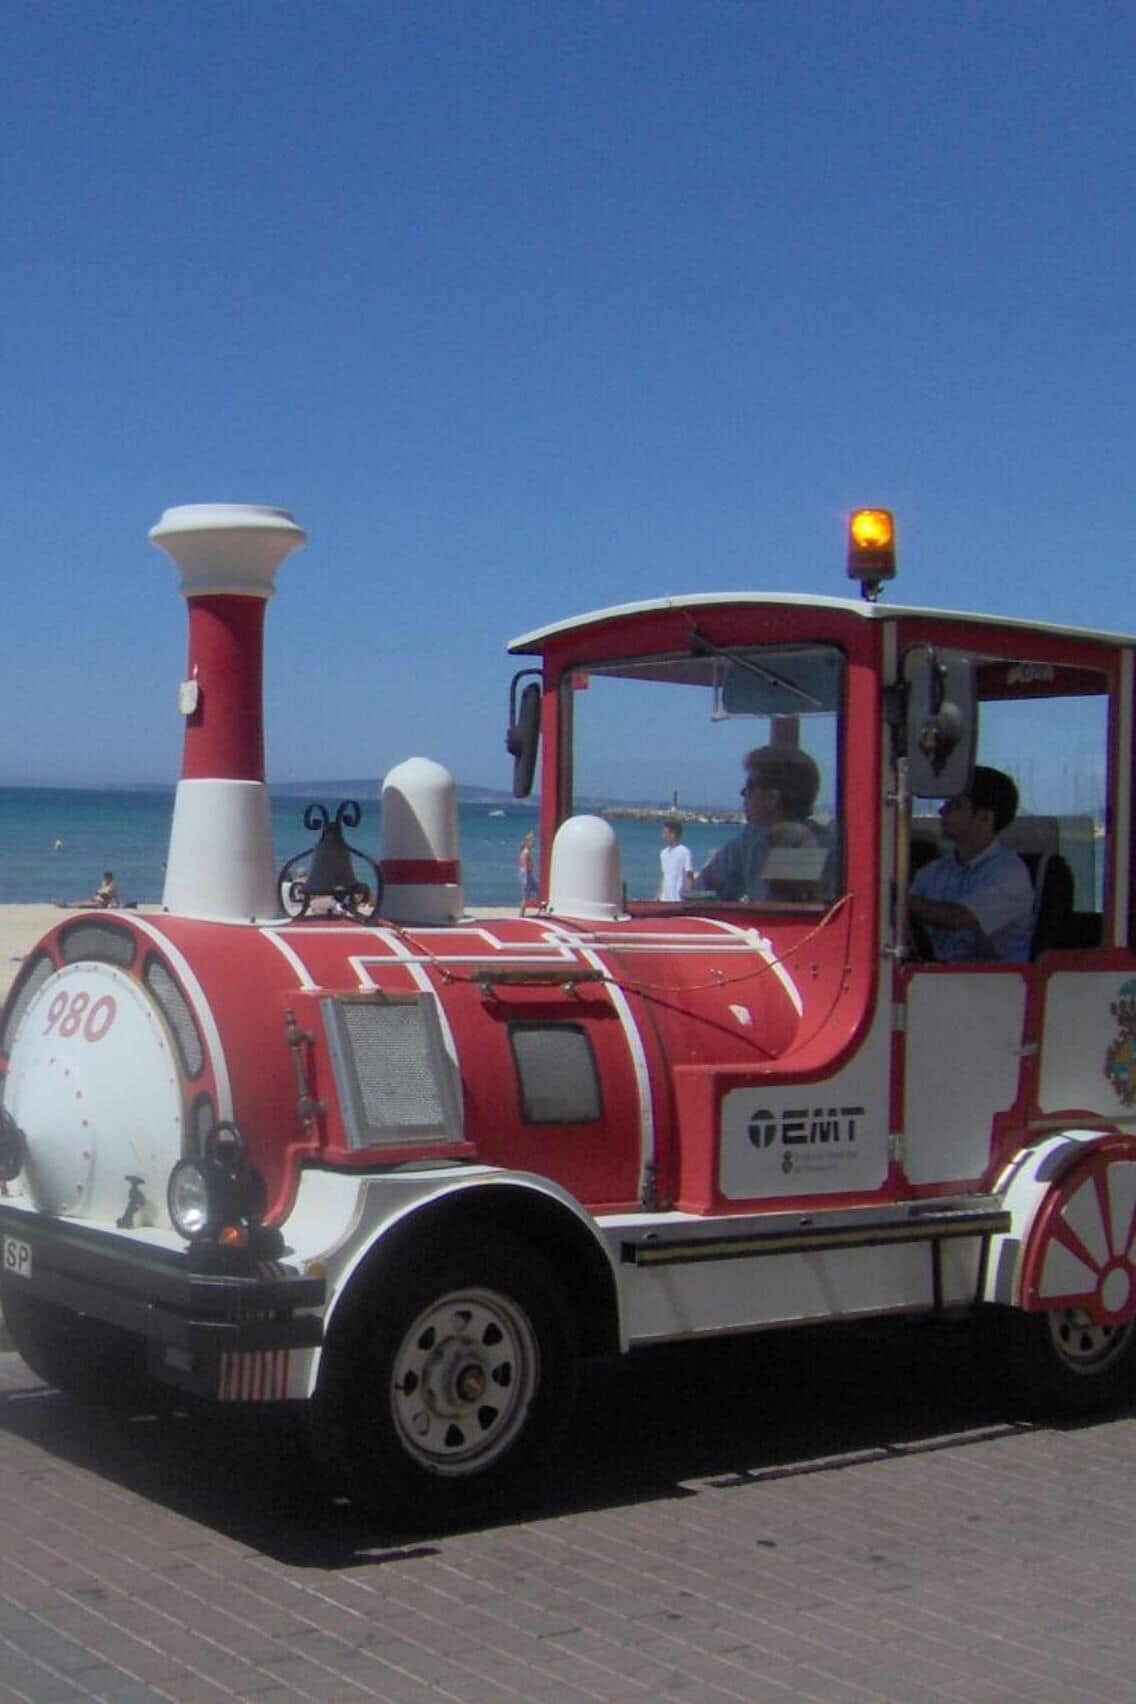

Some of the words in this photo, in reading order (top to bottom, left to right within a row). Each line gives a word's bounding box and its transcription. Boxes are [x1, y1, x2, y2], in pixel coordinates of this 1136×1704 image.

[41, 991, 117, 1042] 980
[781, 1106, 865, 1145] EMT
[6, 1240, 30, 1271] SP
